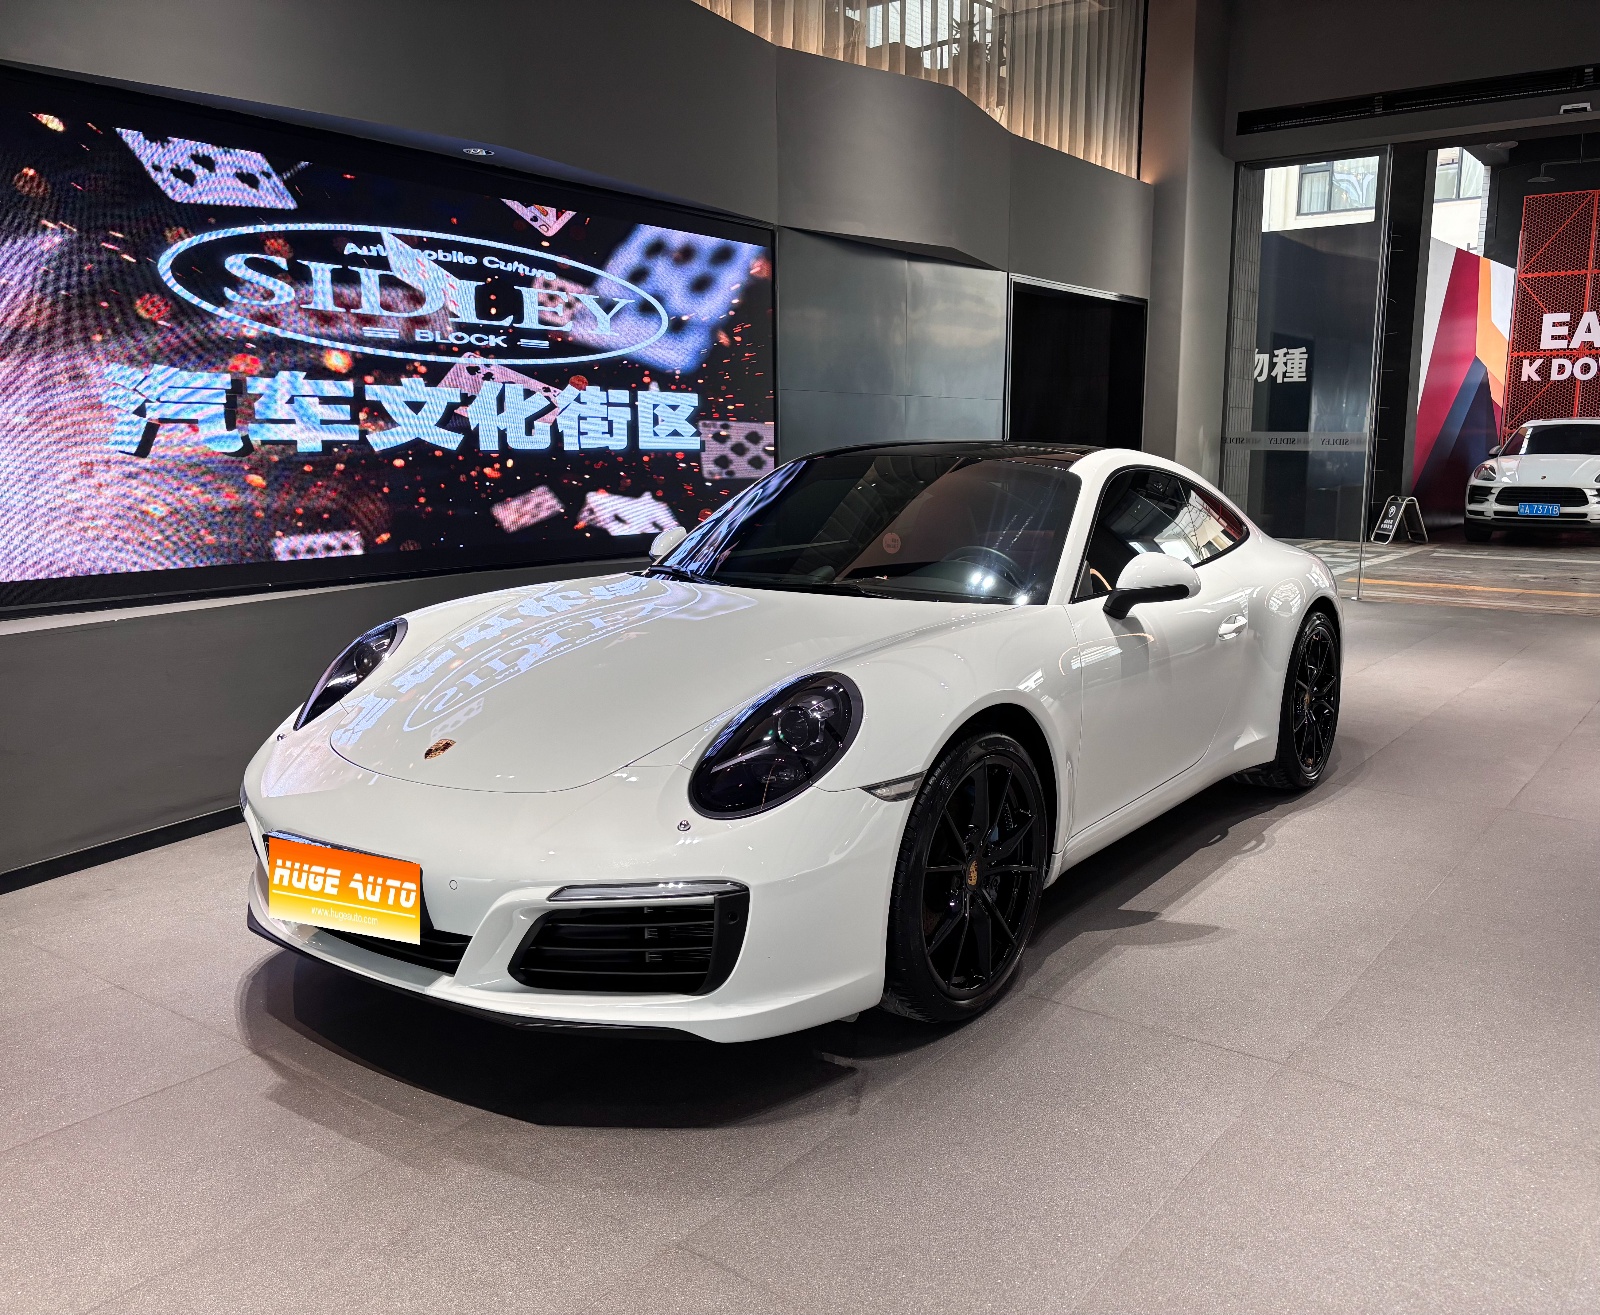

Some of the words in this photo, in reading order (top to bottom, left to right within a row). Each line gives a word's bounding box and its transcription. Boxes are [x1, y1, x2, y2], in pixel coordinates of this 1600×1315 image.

[343, 242, 478, 265] Autobile
[483, 256, 557, 281] Culture
[223, 252, 637, 336] SIDLEY
[415, 329, 507, 347] BLOCK
[1540, 310, 1600, 349] EA
[1550, 357, 1600, 381] DO
[102, 362, 702, 454] 汽车文化街区
